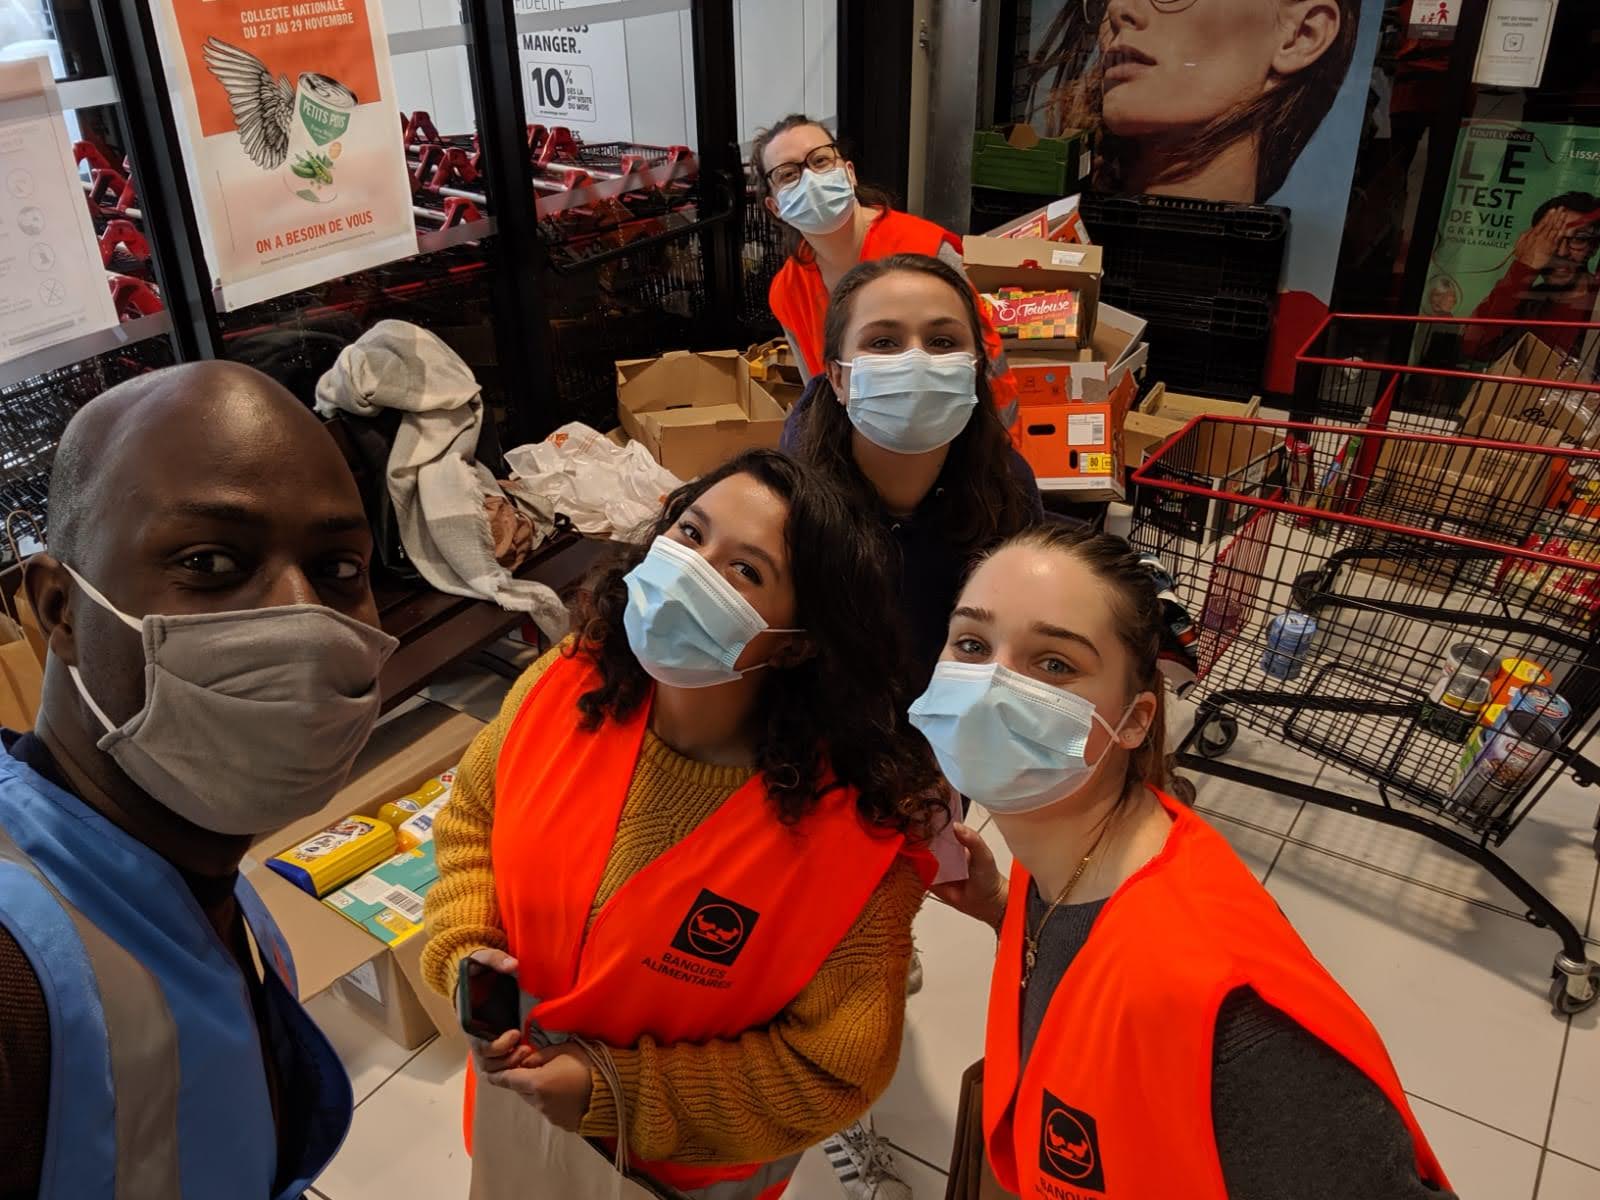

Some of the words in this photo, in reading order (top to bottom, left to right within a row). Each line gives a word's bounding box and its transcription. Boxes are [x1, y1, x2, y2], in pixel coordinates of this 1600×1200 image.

[240, 6, 291, 24] COLLECTE
[292, 0, 346, 17] NATIONALE
[243, 26, 257, 39] DU
[259, 24, 272, 37] 27
[275, 22, 289, 35] AU
[290, 19, 302, 32] 29
[304, 12, 355, 31] NOVEMBRE
[522, 34, 582, 54] MANGER.
[531, 67, 565, 109] 10
[302, 99, 329, 124] PETITS
[1459, 140, 1532, 185] LE
[1456, 184, 1524, 210] TEST
[256, 238, 272, 254] ON
[275, 234, 284, 249] A
[286, 223, 327, 246] BESOIN
[329, 218, 344, 234] DE
[345, 210, 374, 229] VOUS
[1449, 209, 1473, 224] DE
[1479, 212, 1514, 229] VUE
[1447, 225, 1512, 240] GRATUIT
[1016, 300, 1070, 317] Toulouse
[641, 956, 735, 989] ALIMENTAIRES
[662, 952, 727, 979] BANQUES
